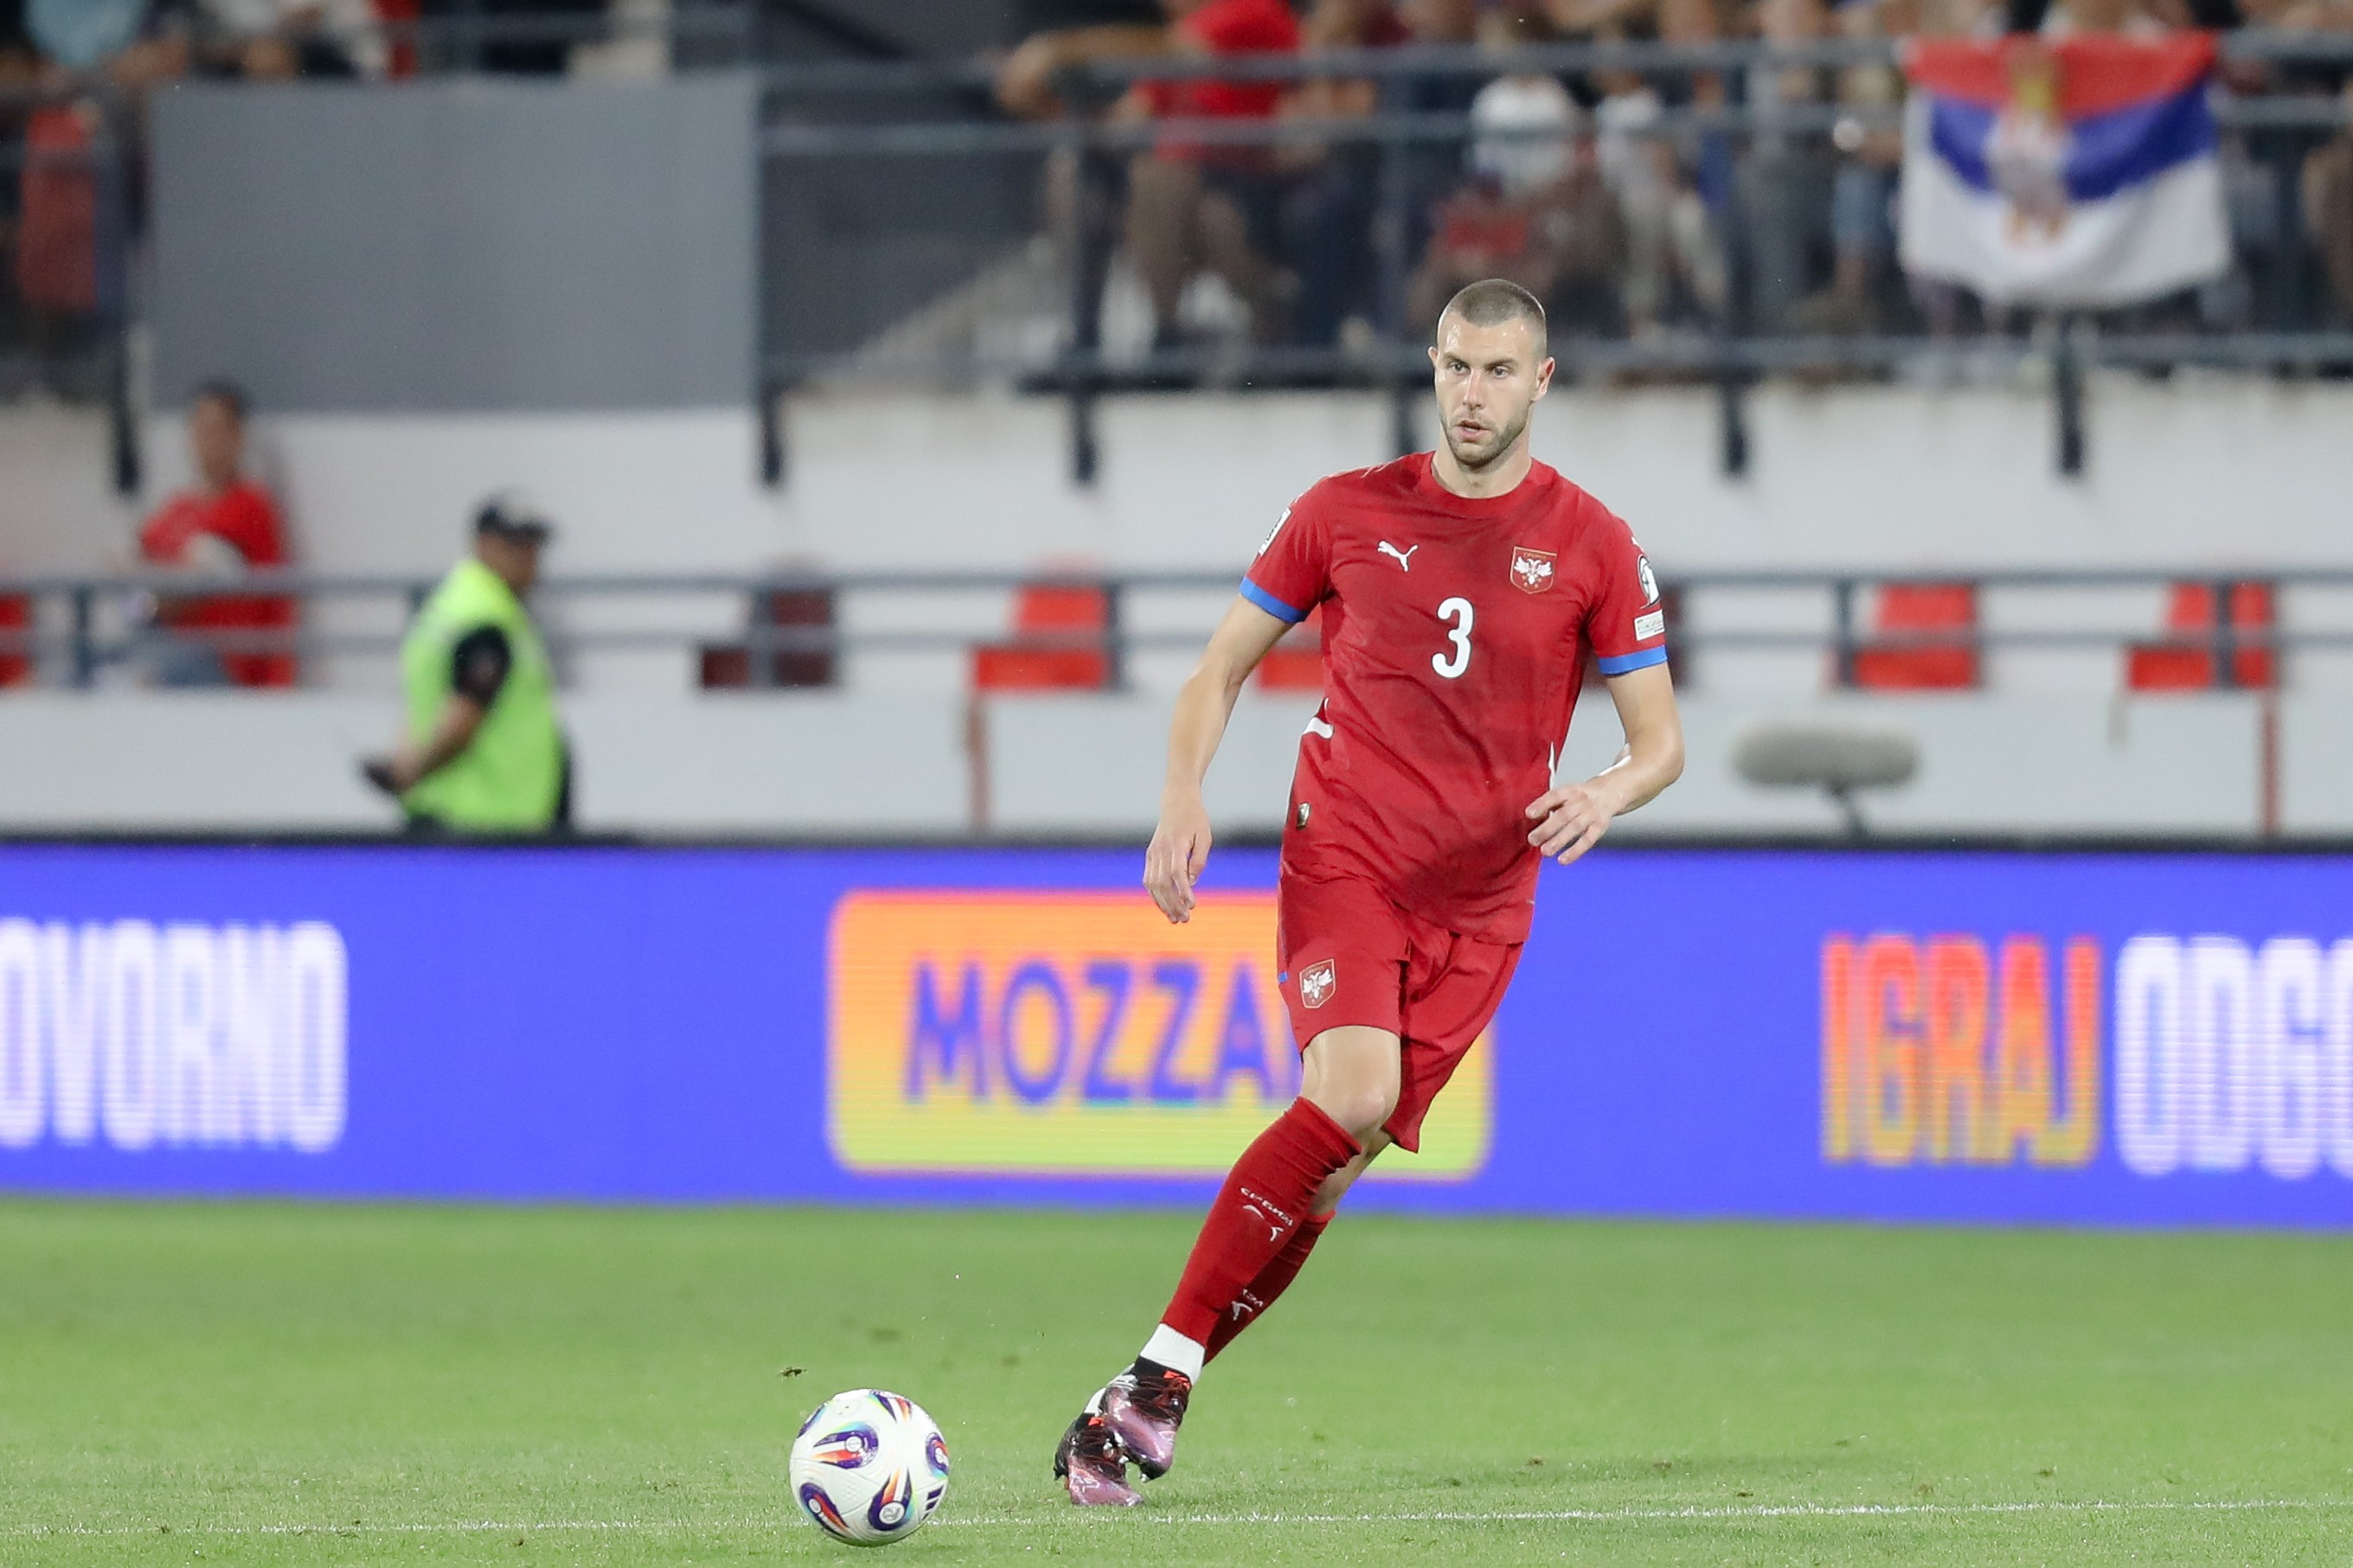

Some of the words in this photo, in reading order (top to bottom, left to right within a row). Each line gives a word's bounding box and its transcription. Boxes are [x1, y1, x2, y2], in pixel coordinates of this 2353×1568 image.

[1432, 597, 1474, 678] 3
[905, 960, 1300, 1104] MOZZA
[1822, 935, 2101, 1168] IGRAJ
